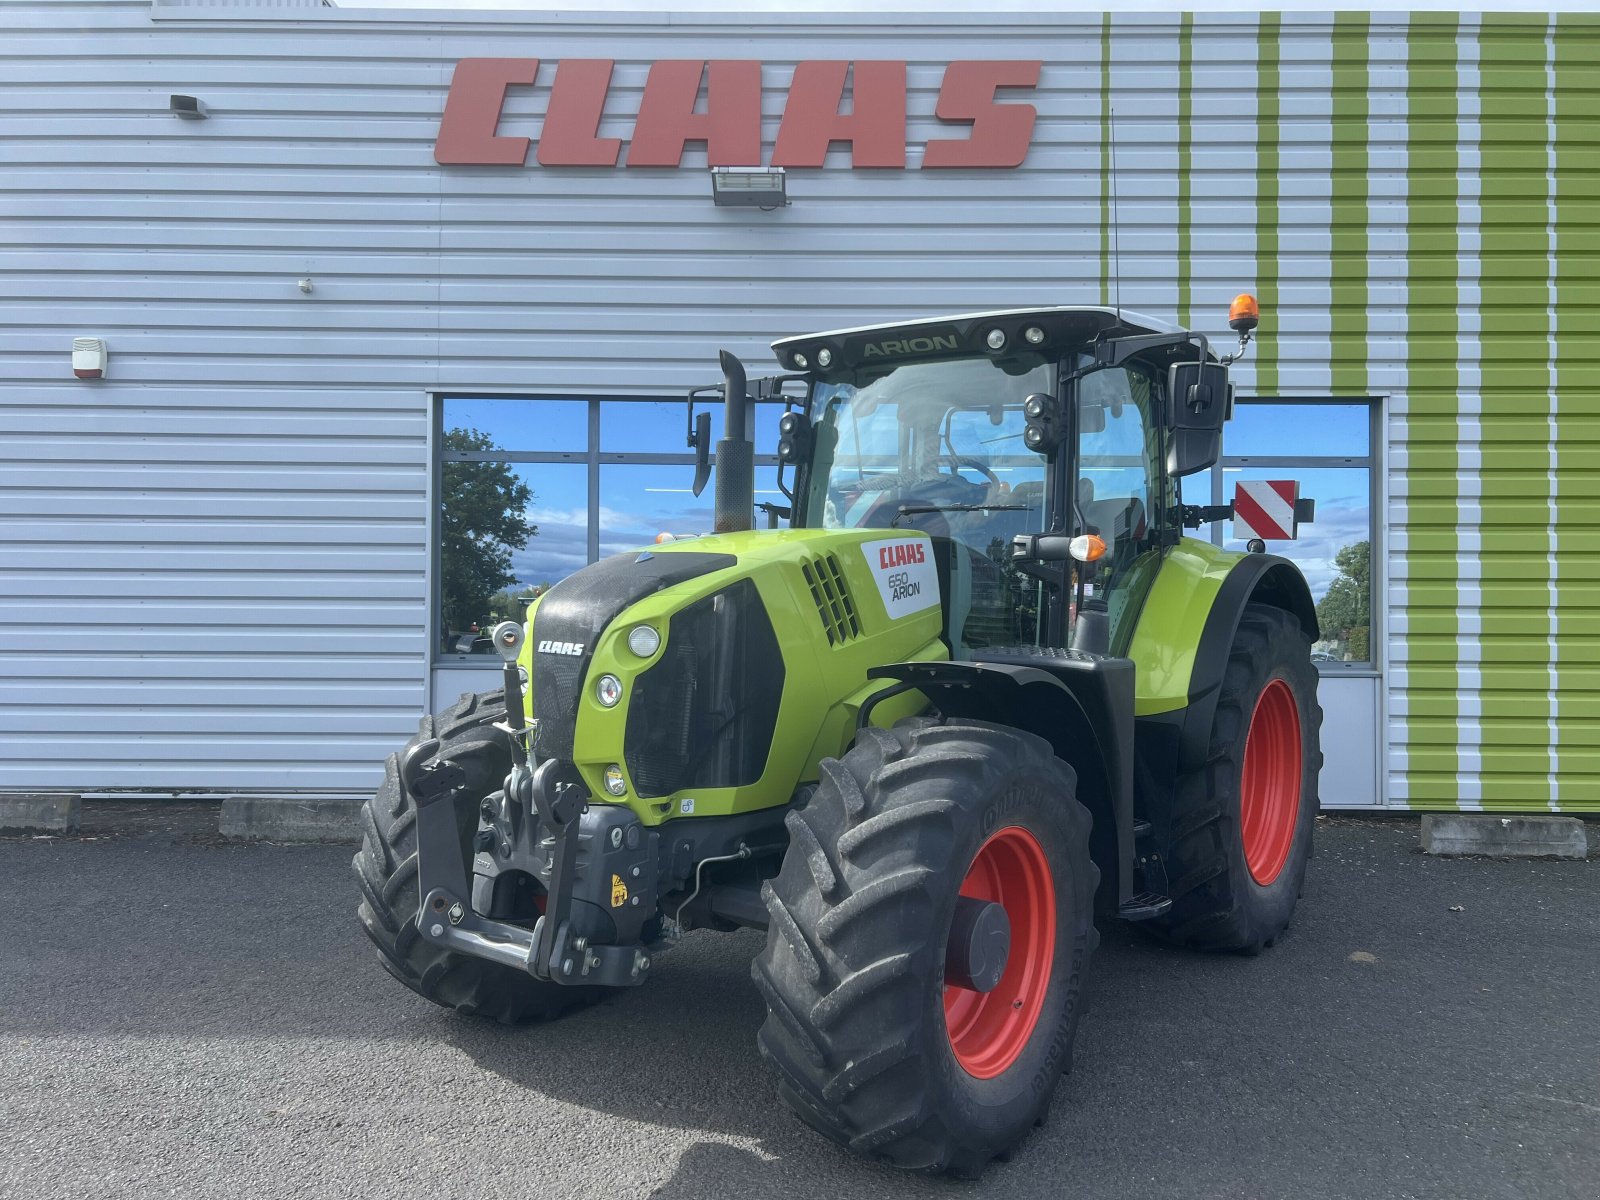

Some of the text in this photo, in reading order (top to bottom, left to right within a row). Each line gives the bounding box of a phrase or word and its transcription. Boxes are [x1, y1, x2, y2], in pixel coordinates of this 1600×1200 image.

[433, 57, 1043, 169] CLAAS
[863, 335, 958, 357] ARION
[879, 543, 925, 569] CLAAS
[888, 572, 908, 589] 650
[892, 581, 920, 602] ARION
[537, 640, 585, 656] CLAAS
